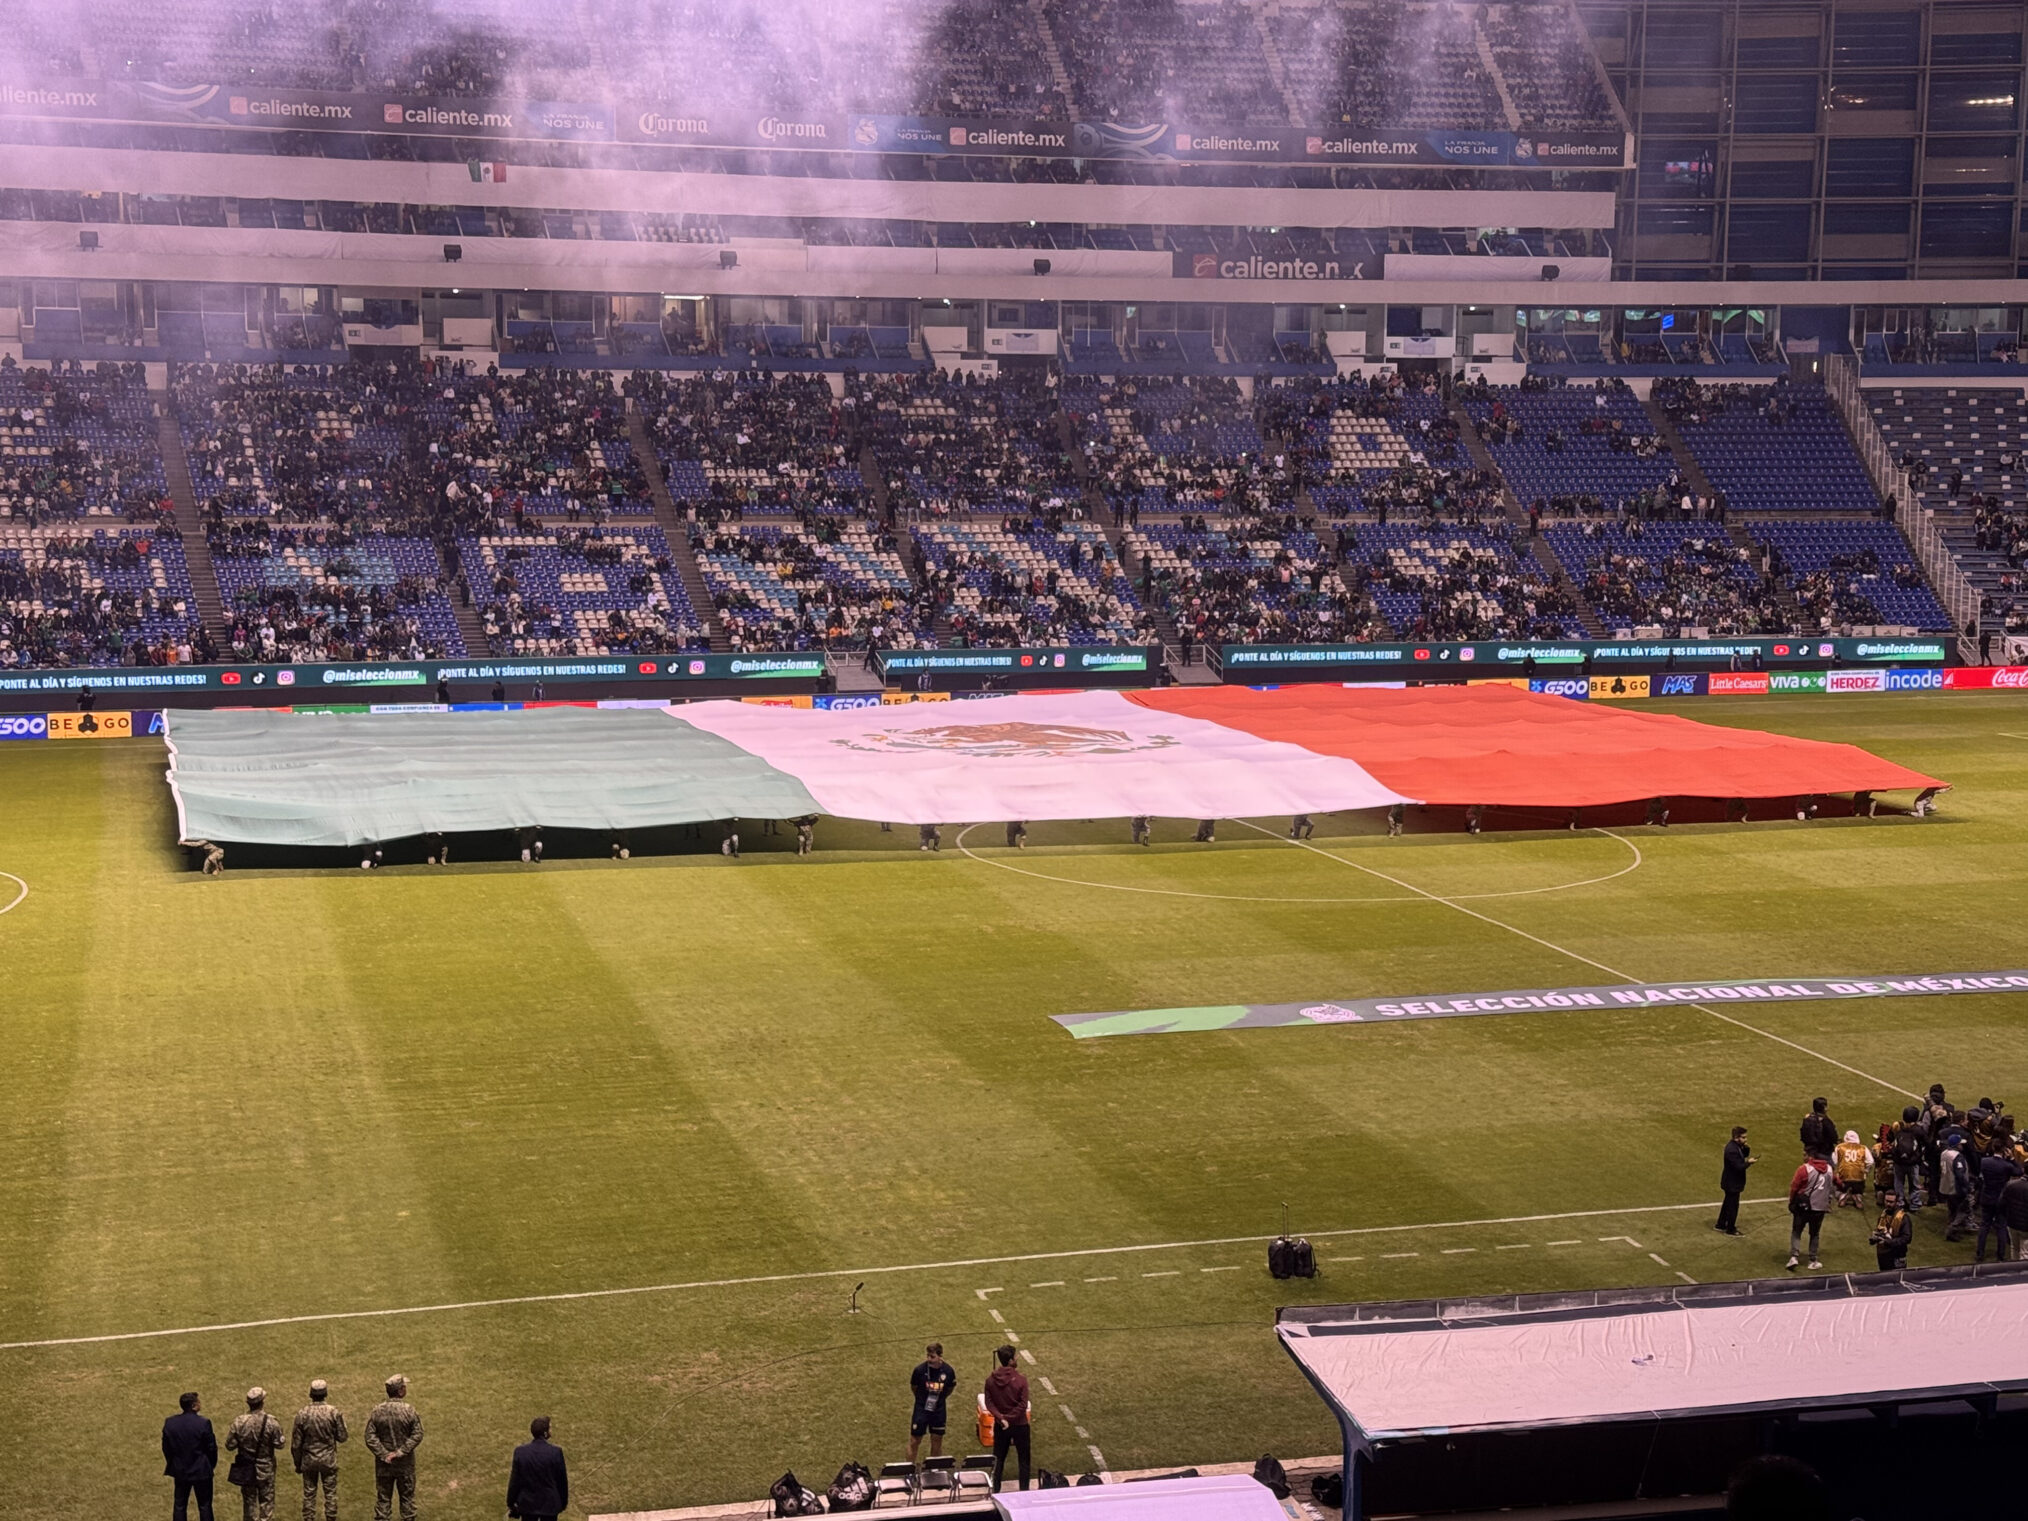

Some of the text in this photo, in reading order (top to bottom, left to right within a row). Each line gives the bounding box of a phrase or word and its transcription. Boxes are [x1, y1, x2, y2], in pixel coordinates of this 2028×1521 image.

[0, 85, 97, 106] liente.mx
[250, 99, 352, 119] caliente.mx
[405, 106, 512, 128] caliente.mx
[544, 119, 604, 129] NOS UNE
[638, 112, 708, 136] Corona
[758, 116, 826, 141] Corona
[968, 130, 1065, 146] caliente.mx
[1192, 136, 1280, 150] caliente.mx
[1325, 138, 1418, 154] caliente.mx
[1473, 146, 1498, 154] UNE
[1550, 144, 1618, 156] caliente.mx
[1259, 652, 1270, 662] AL
[1270, 650, 1284, 661] DÍA
[1284, 652, 1290, 661] Y
[1290, 650, 1326, 661] SÍGUENOS
[1326, 651, 1337, 660] EN
[1338, 650, 1374, 660] NUESTRAS
[1375, 650, 1402, 660] REDES!
[1620, 648, 1630, 657] AL
[1631, 646, 1644, 656] DÍA
[1644, 647, 1650, 656] Y
[1686, 647, 1696, 656] EN
[1698, 646, 1734, 656] NUESTRAS
[1857, 644, 1940, 656] @miseleccionmx
[731, 659, 819, 674] @miseleccionmx
[906, 658, 914, 667] AL
[914, 656, 924, 667] DÍA
[924, 658, 928, 666] Y
[928, 656, 956, 666] SÍGUENOS
[956, 657, 964, 666] EN
[964, 656, 992, 666] NUESTRAS
[992, 656, 1012, 666] REDES!
[323, 668, 420, 684] @miseleccionmx
[468, 667, 479, 678] AL
[480, 666, 494, 677] DÍA
[495, 667, 501, 677] Y
[502, 665, 542, 676] SÍGUENOS
[543, 666, 554, 676] EN
[556, 665, 596, 676] NUESTRAS
[597, 664, 626, 674] REDES!
[30, 678, 41, 688] AL
[42, 676, 58, 688] DÍA
[59, 678, 66, 688] Y
[114, 677, 126, 686] EN
[128, 676, 173, 686] NUESTRAS
[174, 674, 206, 685] REDES!
[1590, 680, 1648, 692] BE GO
[1710, 678, 1768, 689] Little Caesars
[1830, 677, 1880, 689] HERDEZ
[1886, 670, 1942, 688] incode
[1544, 680, 1588, 695] G500
[0, 718, 46, 734] 500
[104, 718, 129, 728] GO
[1376, 976, 2028, 1017] SELECCIÓN NACIONAL DE MÉXICO
[1844, 1150, 1857, 1162] 50
